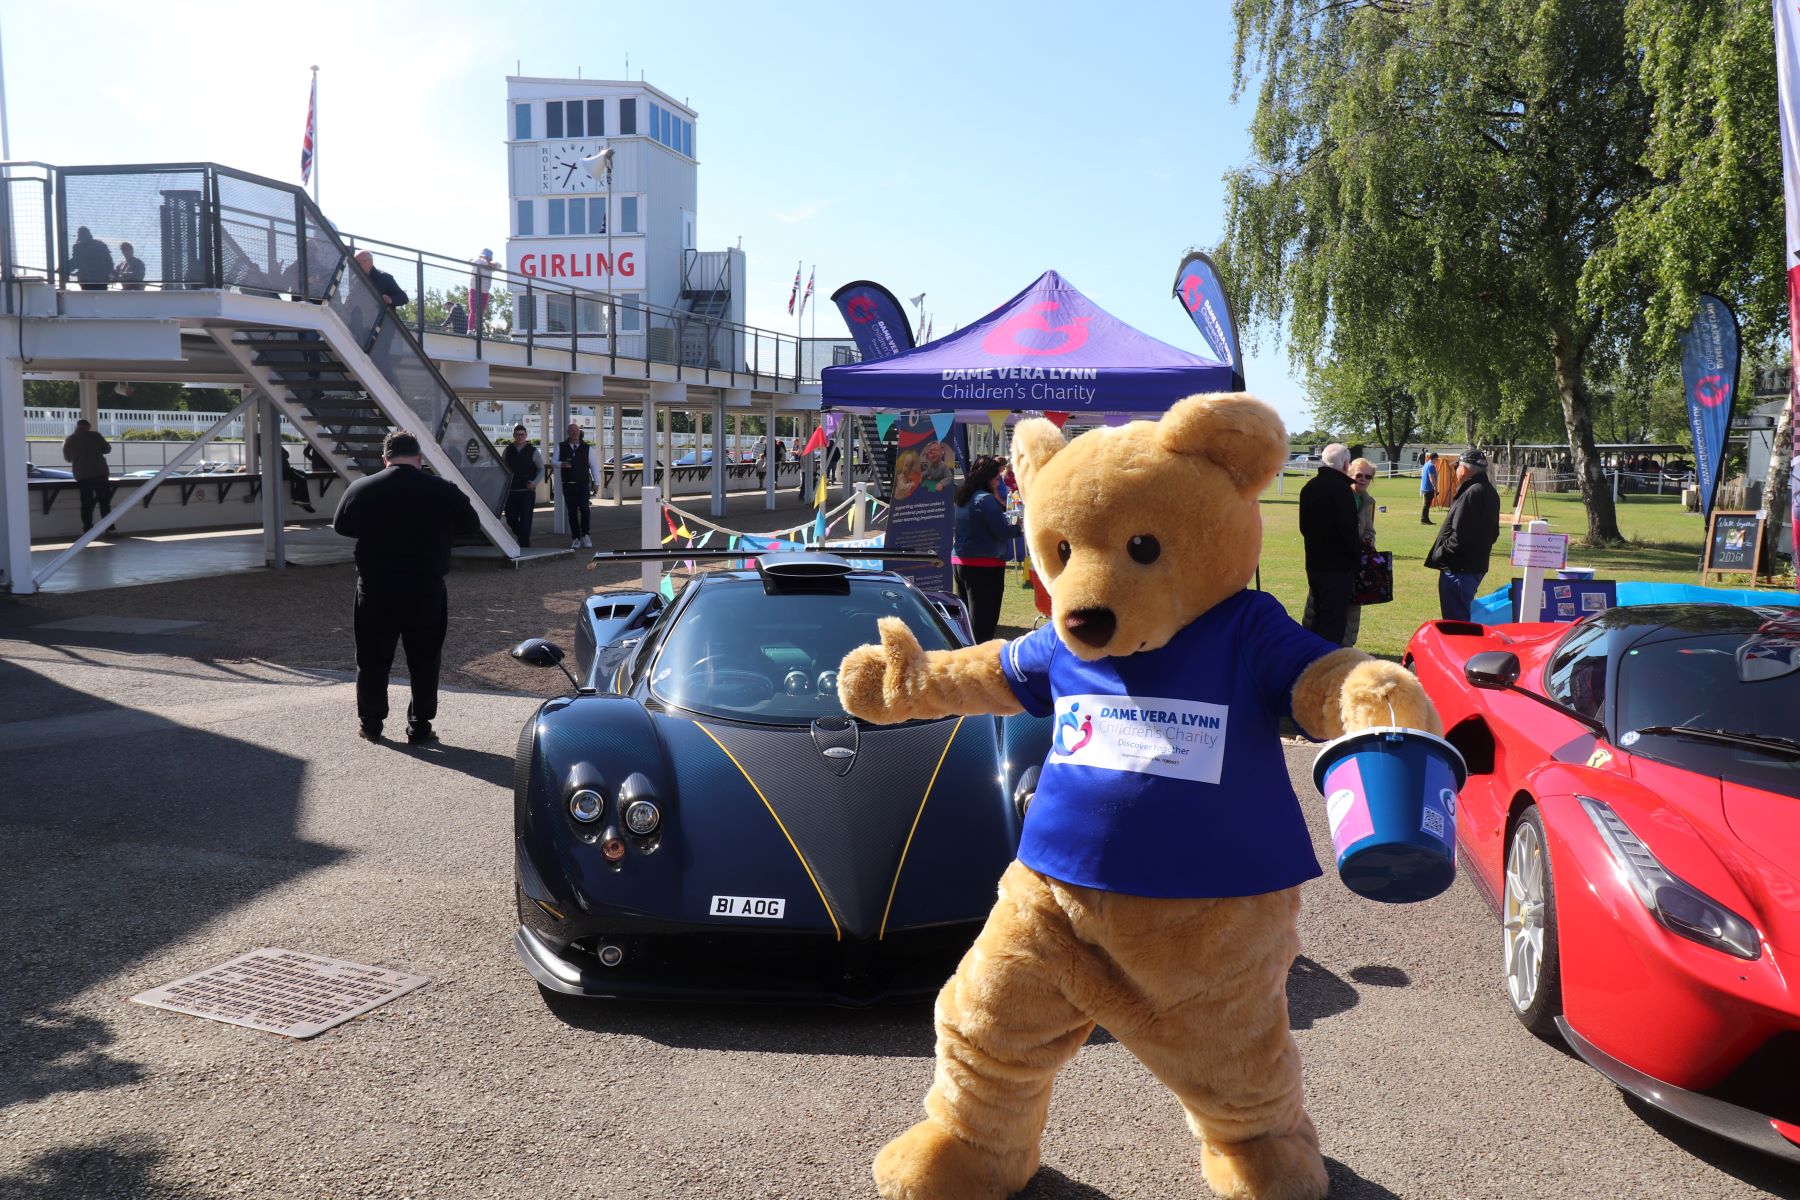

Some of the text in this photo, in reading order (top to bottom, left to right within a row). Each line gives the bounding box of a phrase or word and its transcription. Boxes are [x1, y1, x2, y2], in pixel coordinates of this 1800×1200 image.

[520, 252, 635, 278] GIRLING
[942, 367, 1097, 380] DAME VERA LYNN
[941, 383, 1095, 404] Children's Charity
[1100, 707, 1220, 729] DAME VERA LYNN
[1099, 720, 1218, 749] Children's Charity
[1118, 739, 1190, 756] Discover together
[741, 900, 779, 915] AOG
